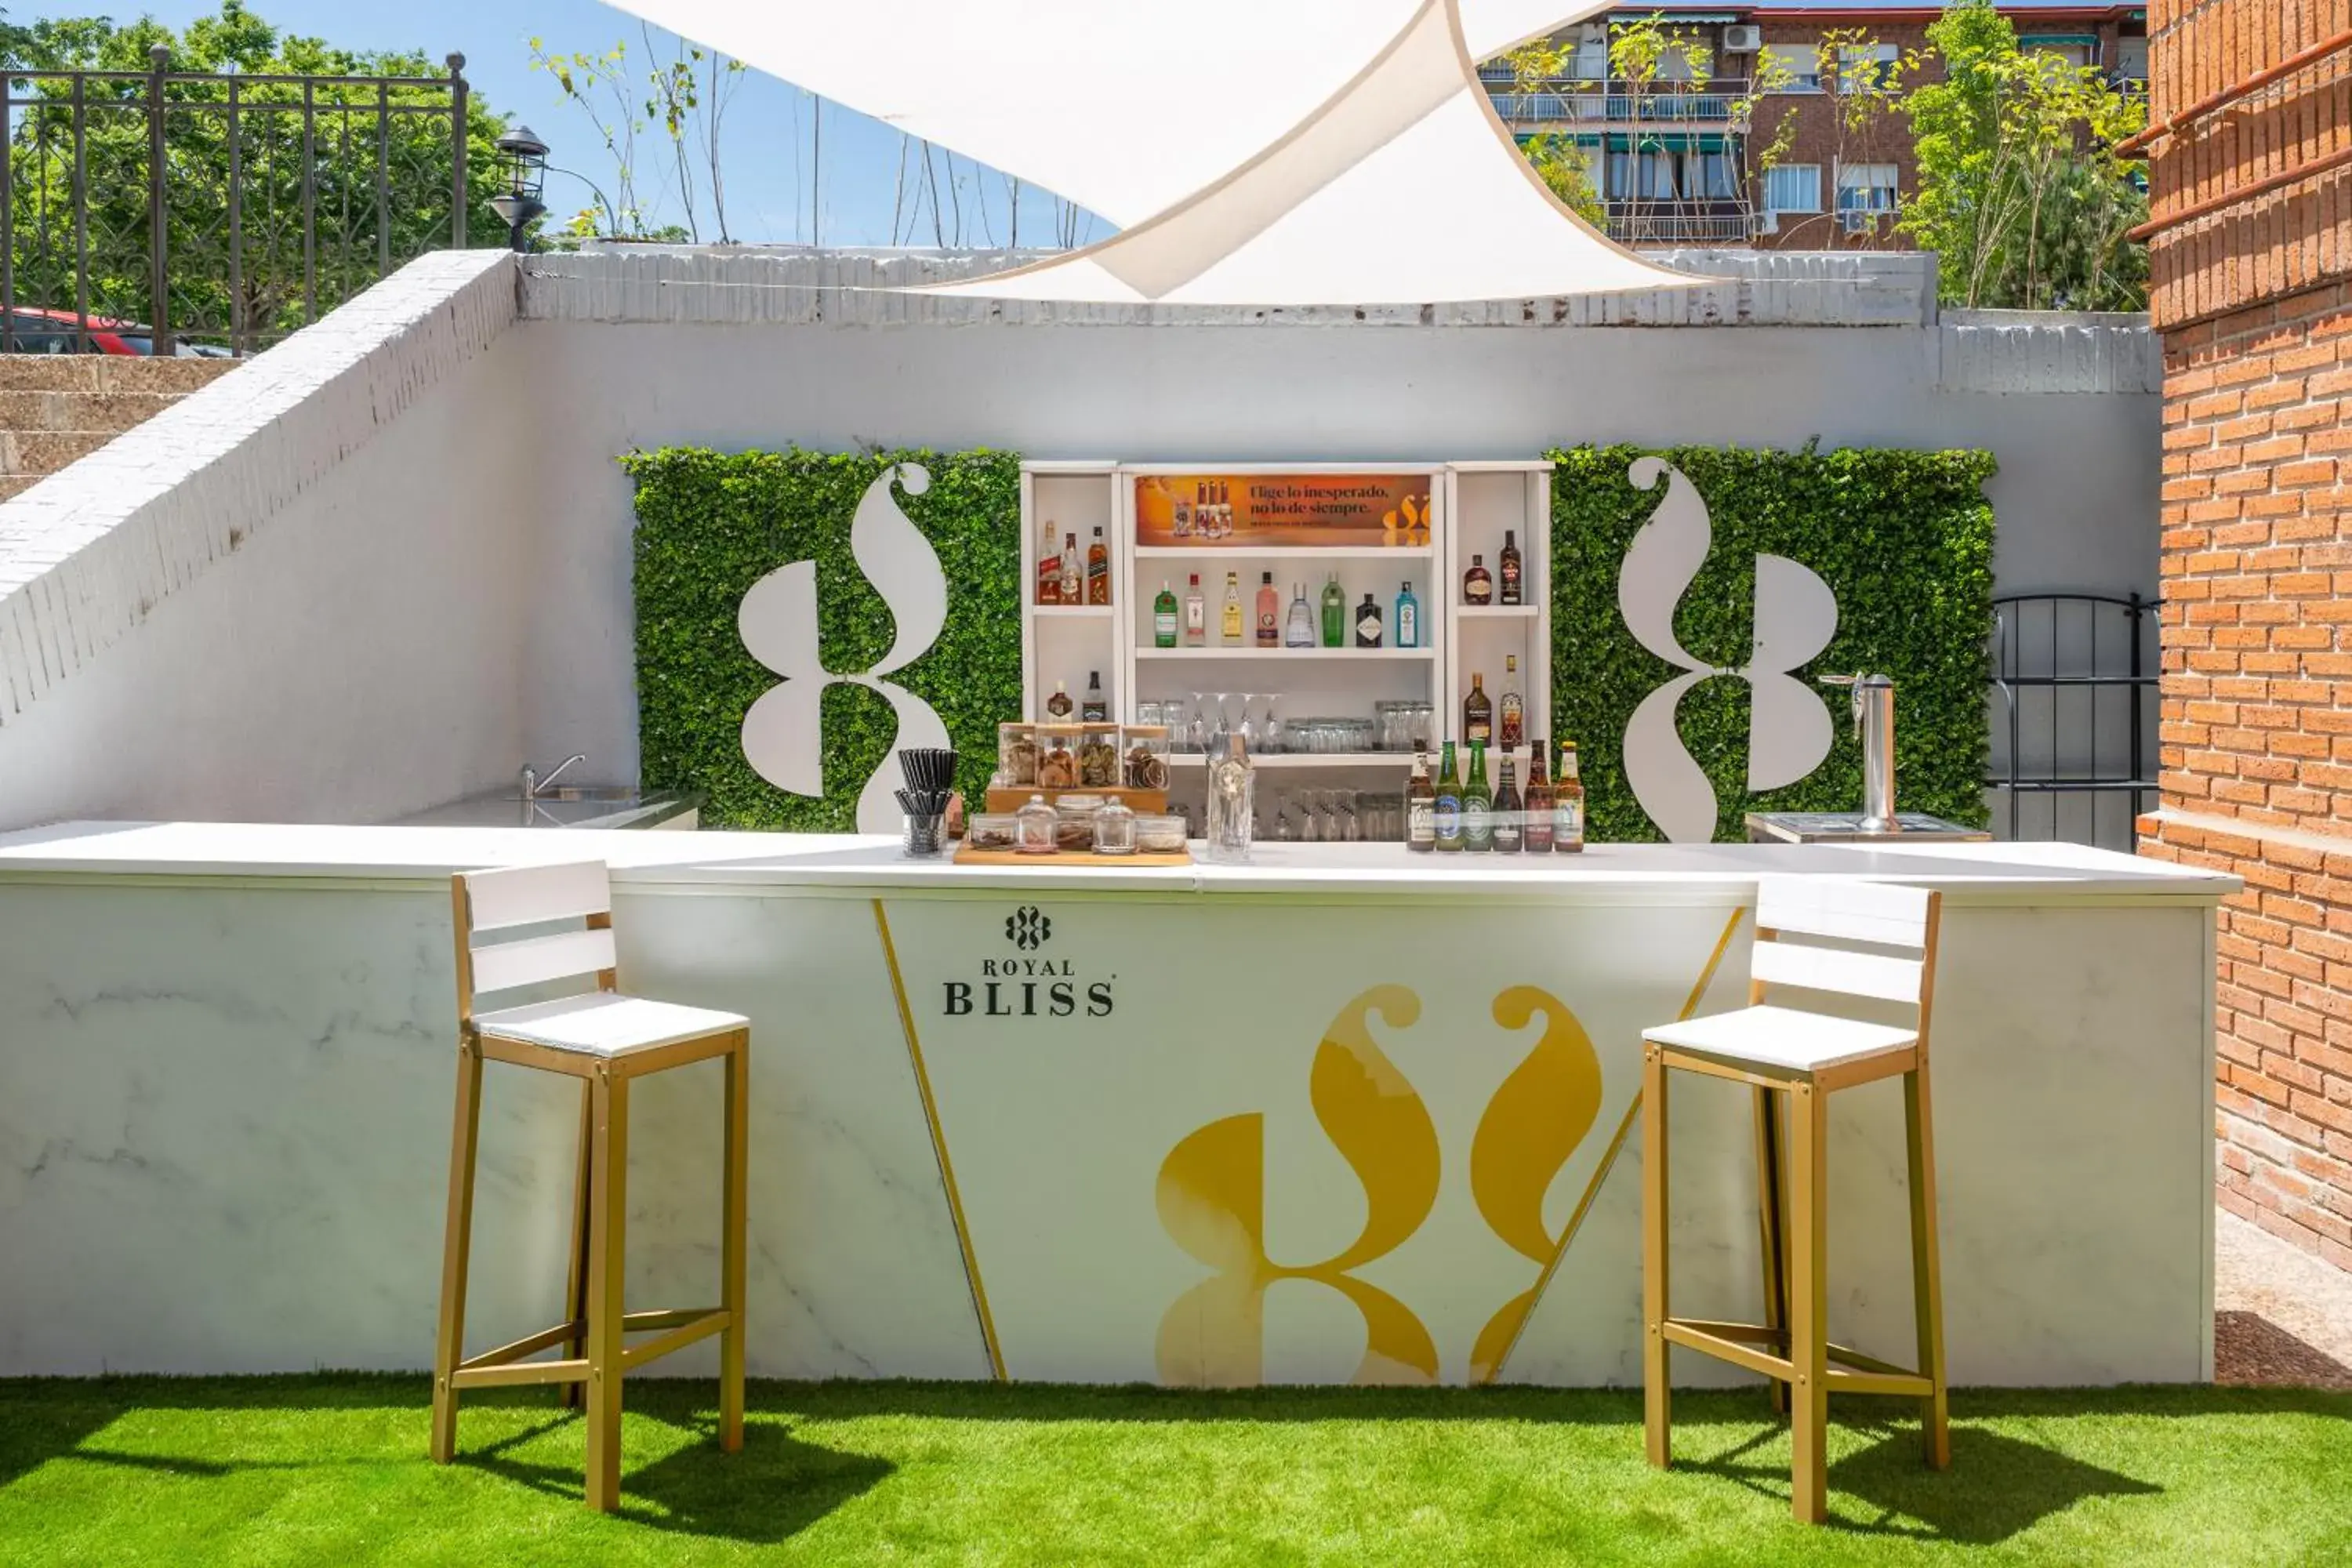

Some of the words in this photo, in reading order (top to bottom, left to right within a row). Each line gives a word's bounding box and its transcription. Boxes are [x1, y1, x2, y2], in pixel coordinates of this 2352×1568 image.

[1250, 485, 1285, 501] Elige
[1287, 485, 1302, 498] lo
[1305, 485, 1388, 500] inesperado,
[1250, 504, 1269, 514] no
[1271, 501, 1286, 514] lo
[1288, 501, 1306, 514] de
[1309, 501, 1372, 517] siempre.
[982, 960, 1076, 977] ROYAL
[943, 982, 1113, 1017] BLISS
